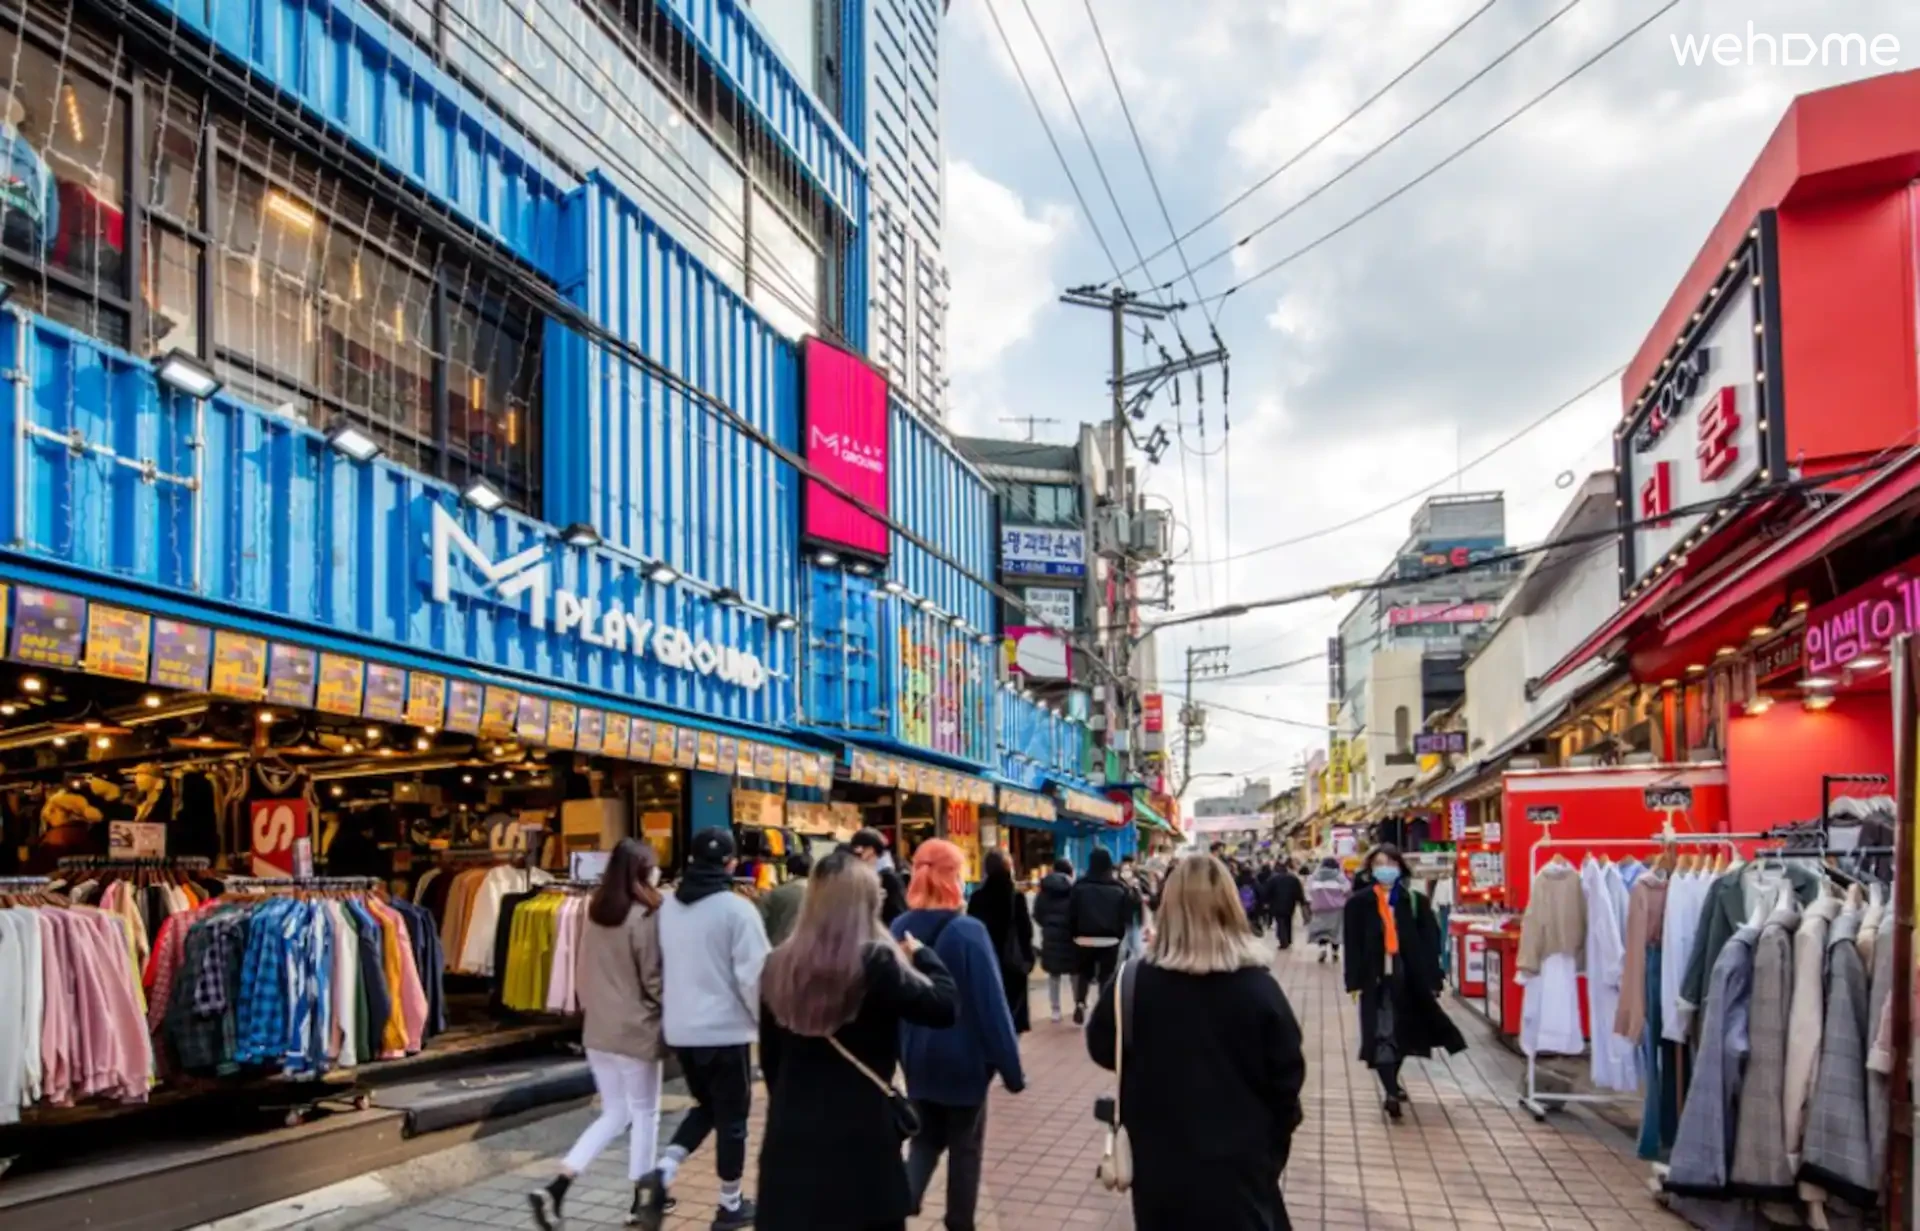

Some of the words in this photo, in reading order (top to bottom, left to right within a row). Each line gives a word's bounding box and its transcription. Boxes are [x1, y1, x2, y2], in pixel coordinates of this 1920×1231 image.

[842, 433, 883, 458] PLAY
[555, 589, 653, 656] PLAY
[652, 624, 769, 691] GROUND
